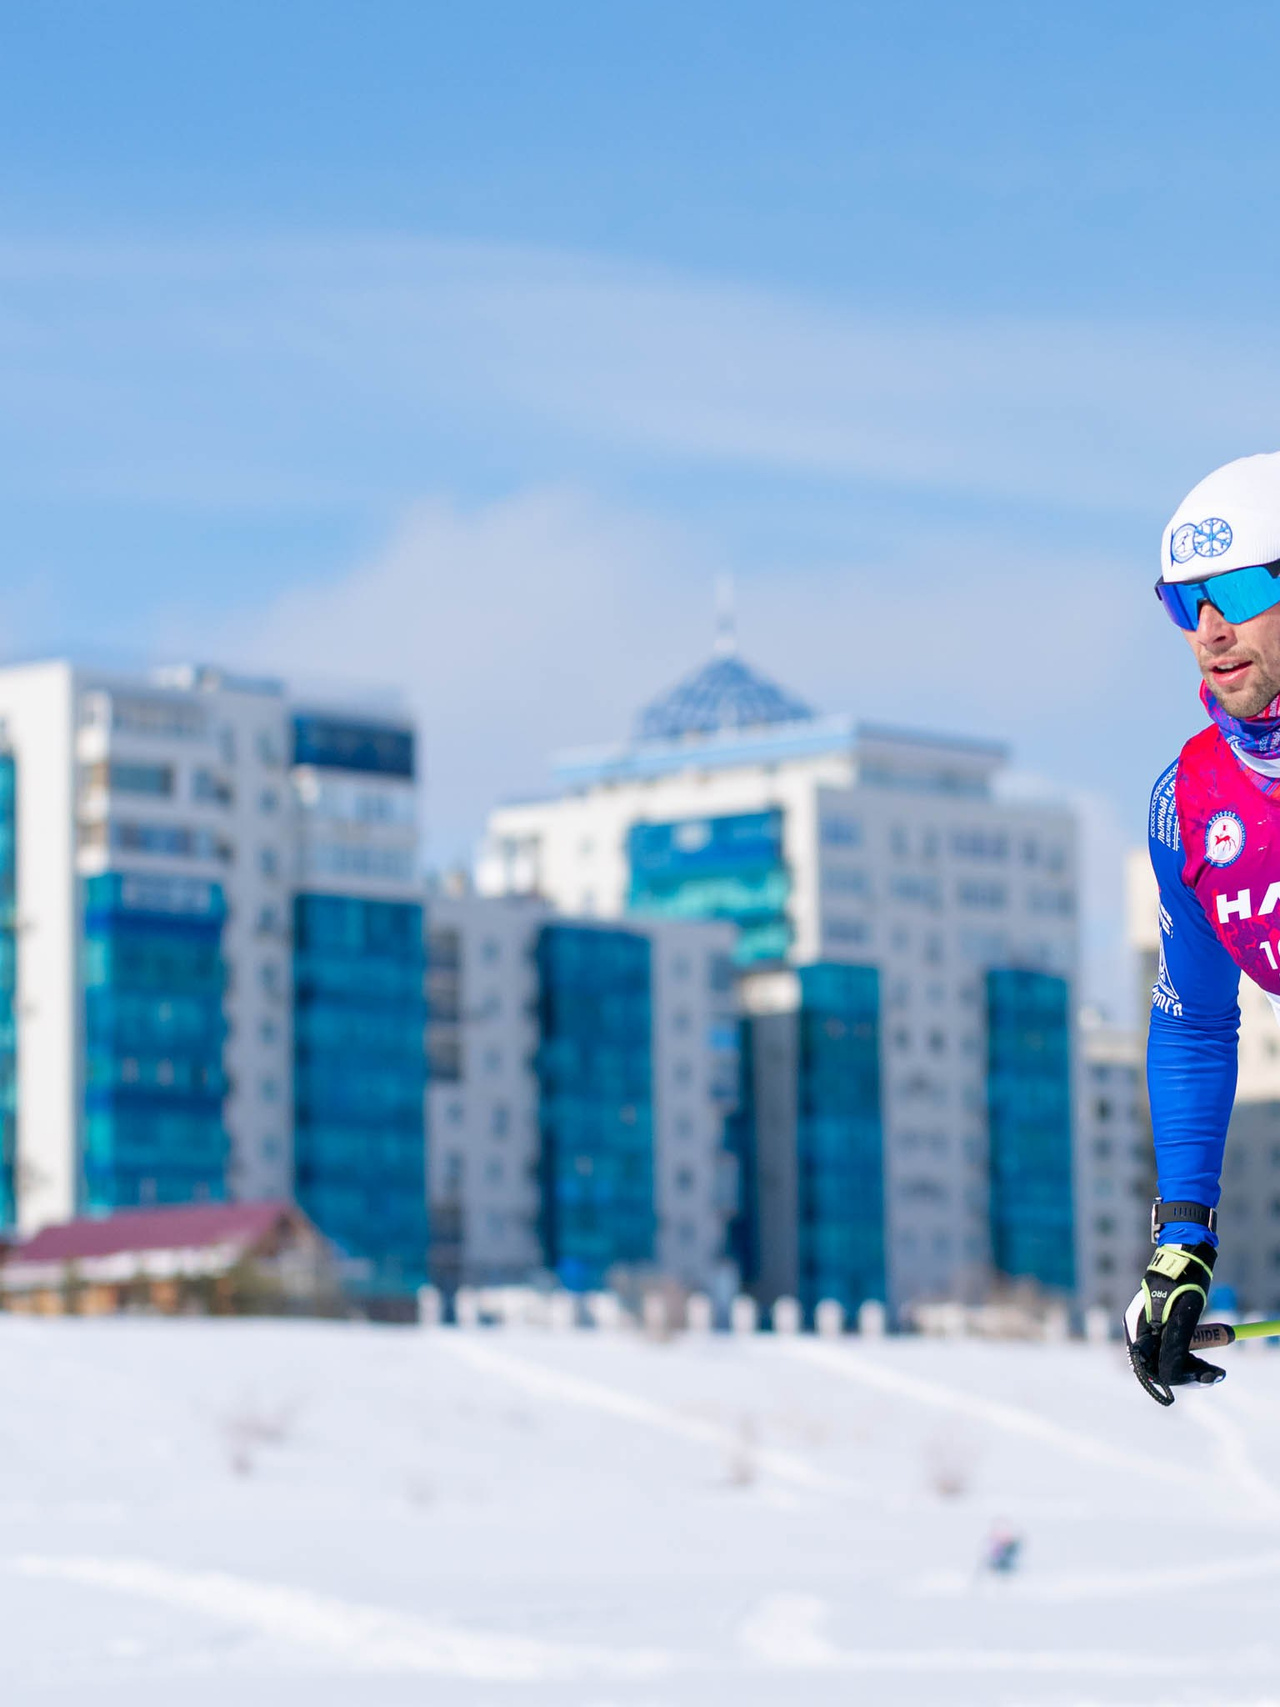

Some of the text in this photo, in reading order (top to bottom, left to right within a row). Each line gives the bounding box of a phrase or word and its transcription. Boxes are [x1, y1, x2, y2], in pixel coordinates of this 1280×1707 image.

[1157, 794, 1169, 844] ЛЫЖНЫЙ
[1151, 1290, 1168, 1299] PRO
[1193, 1328, 1221, 1343] HIDE
